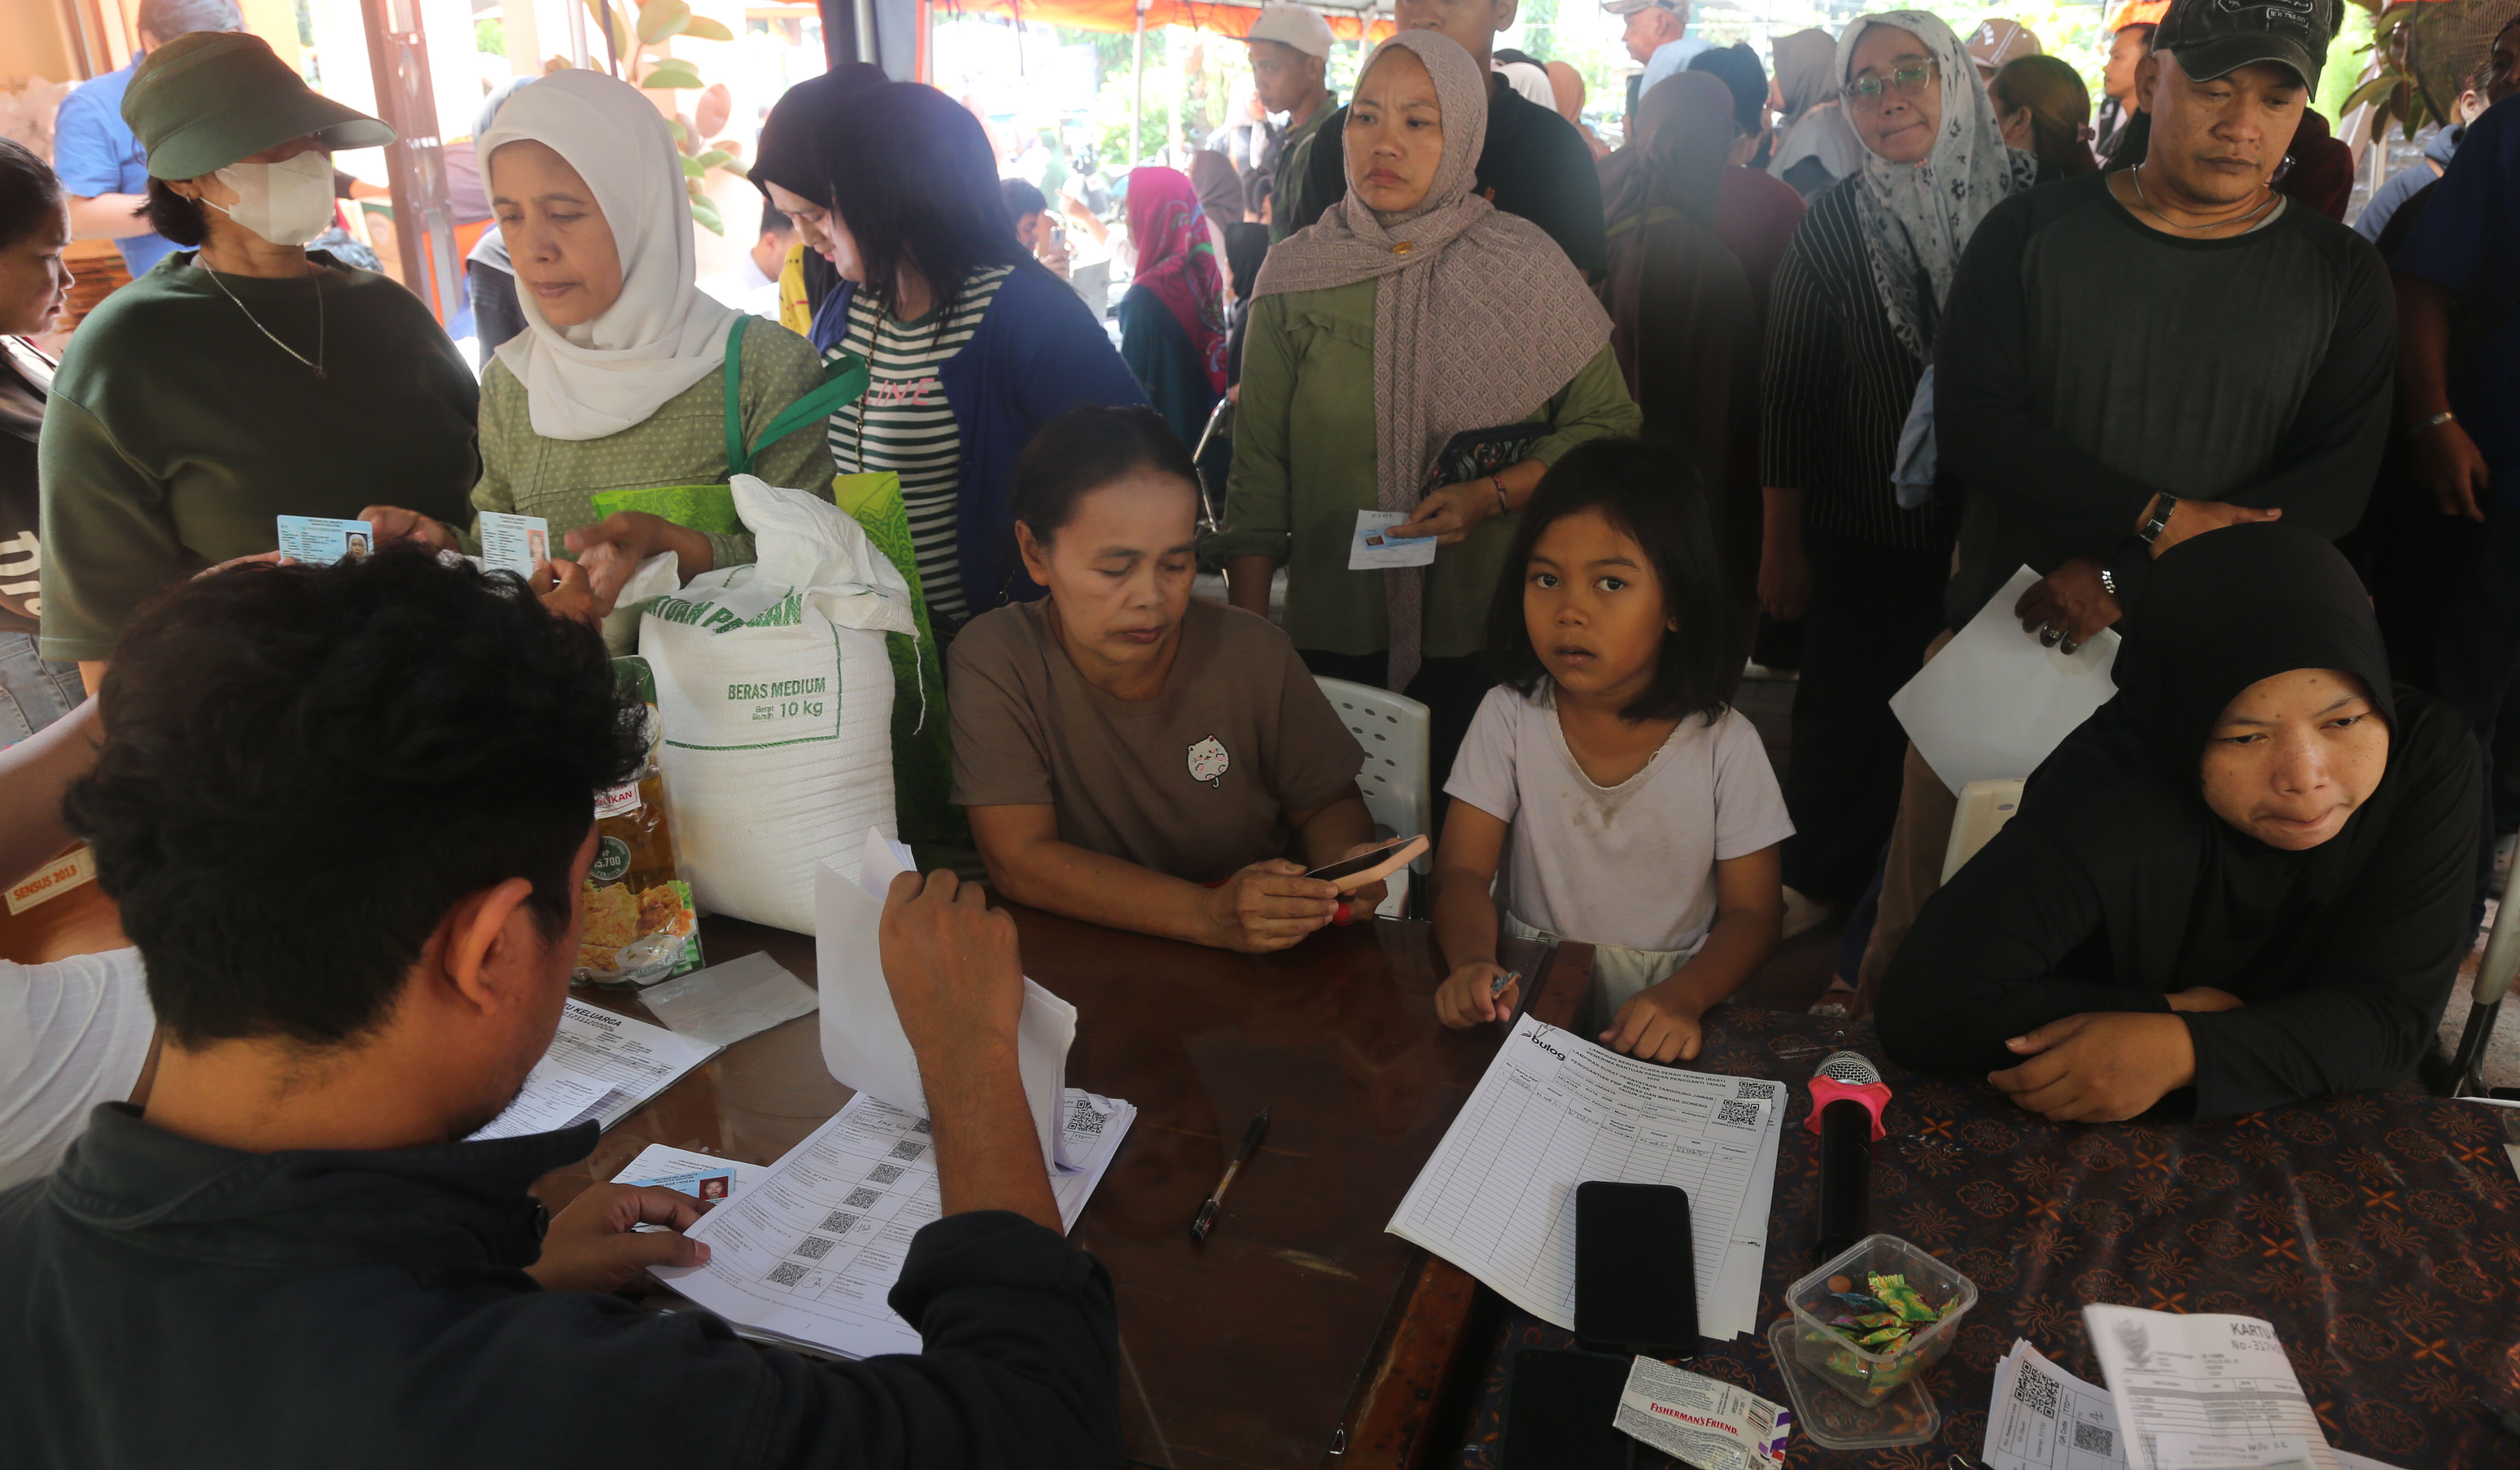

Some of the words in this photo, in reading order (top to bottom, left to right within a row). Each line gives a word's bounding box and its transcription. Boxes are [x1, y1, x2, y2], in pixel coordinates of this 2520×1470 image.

[727, 684, 768, 700] BERAS
[771, 677, 826, 698] MEDIUM
[780, 702, 798, 718] 10
[803, 700, 823, 717] kg
[13, 875, 52, 901] SENSUS
[53, 865, 77, 883] 2013
[574, 1007, 622, 1027] KELUARGA
[1531, 1035, 1566, 1061] bulog
[1588, 1047, 1617, 1061] LAMPIRAN
[1570, 1059, 1609, 1081] PENGGANTIAN
[1623, 1084, 1642, 1093] BERAS
[1572, 1049, 1600, 1066] LAMPIRAN
[1600, 1066, 1618, 1076] SURAT
[1619, 1075, 1657, 1088] PERNYATAAN
[1658, 1087, 1691, 1096] TANGGUNG
[1586, 1051, 1615, 1064] PENERIMA
[1615, 1063, 1643, 1074] BANTUAN
[1670, 1077, 1704, 1085] PENGGANTI
[1594, 1083, 1616, 1095] JAKARTA
[1618, 1087, 1638, 1096] TAHUN
[1626, 1081, 1650, 1090] MUTLAK
[1617, 1102, 1640, 1112] JAKARTA
[2231, 1322, 2272, 1339] KARTU
[1650, 1401, 1706, 1427] FISHERMAN'S
[1705, 1418, 1739, 1436] FRIEND
[2060, 1420, 2068, 1435] Code
[2058, 1435, 2066, 1444] QR
